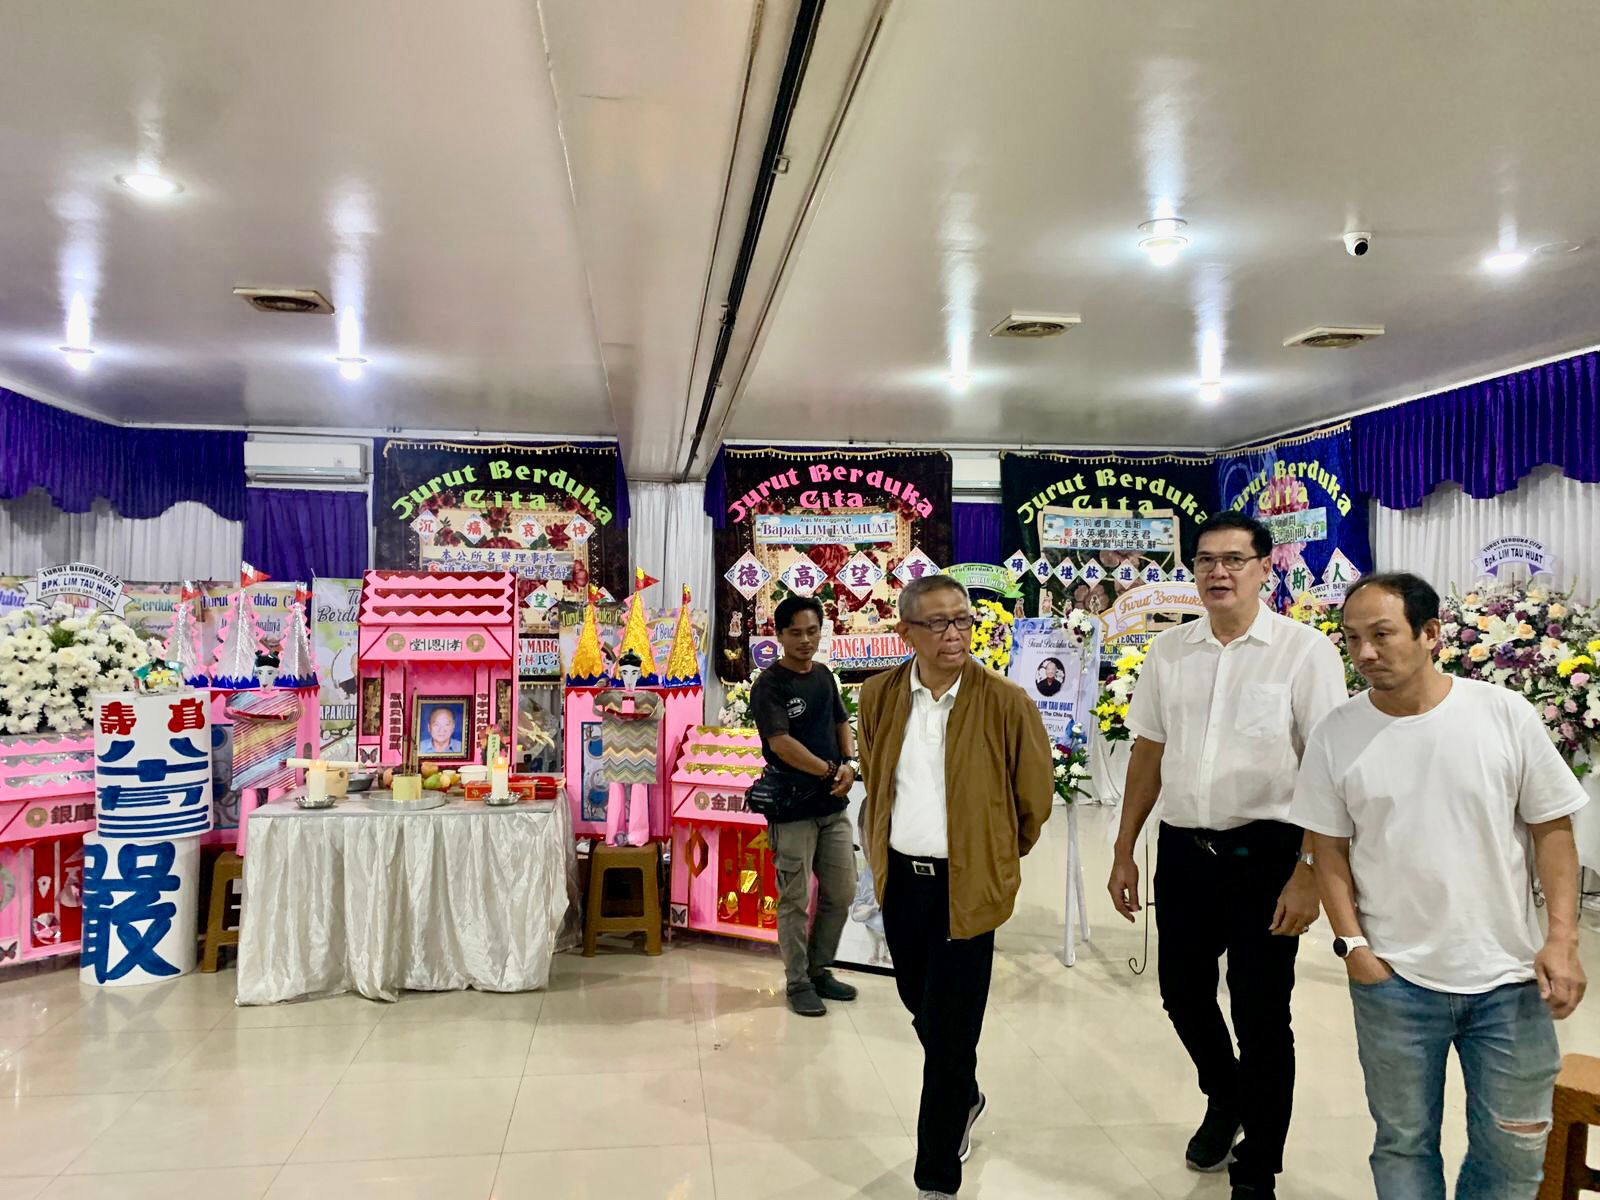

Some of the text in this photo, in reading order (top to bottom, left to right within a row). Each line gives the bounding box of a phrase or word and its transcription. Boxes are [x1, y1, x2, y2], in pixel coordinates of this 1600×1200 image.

[488, 460, 613, 526] Berduka
[800, 489, 863, 508] Cita
[809, 463, 933, 518] Berduka
[1095, 468, 1209, 525] Berduka
[1230, 459, 1352, 517] urut Berduka
[1258, 481, 1309, 510] Cita
[463, 489, 547, 510] Cita
[1072, 495, 1154, 514] Cita
[419, 518, 588, 538] 沉痛哀悼
[763, 522, 889, 537] Bapak LIM TAU HUAT
[1499, 549, 1509, 560] LIM
[1511, 548, 1523, 557] TAU
[1525, 550, 1543, 564] HUAT
[42, 565, 120, 588] TURUT BERDUKA CITA
[41, 578, 116, 600] BPK. LIM TAU HUAT
[527, 640, 560, 653] MARG
[830, 638, 867, 659] PANCA
[1037, 701, 1074, 712] LIM TAU HUAT
